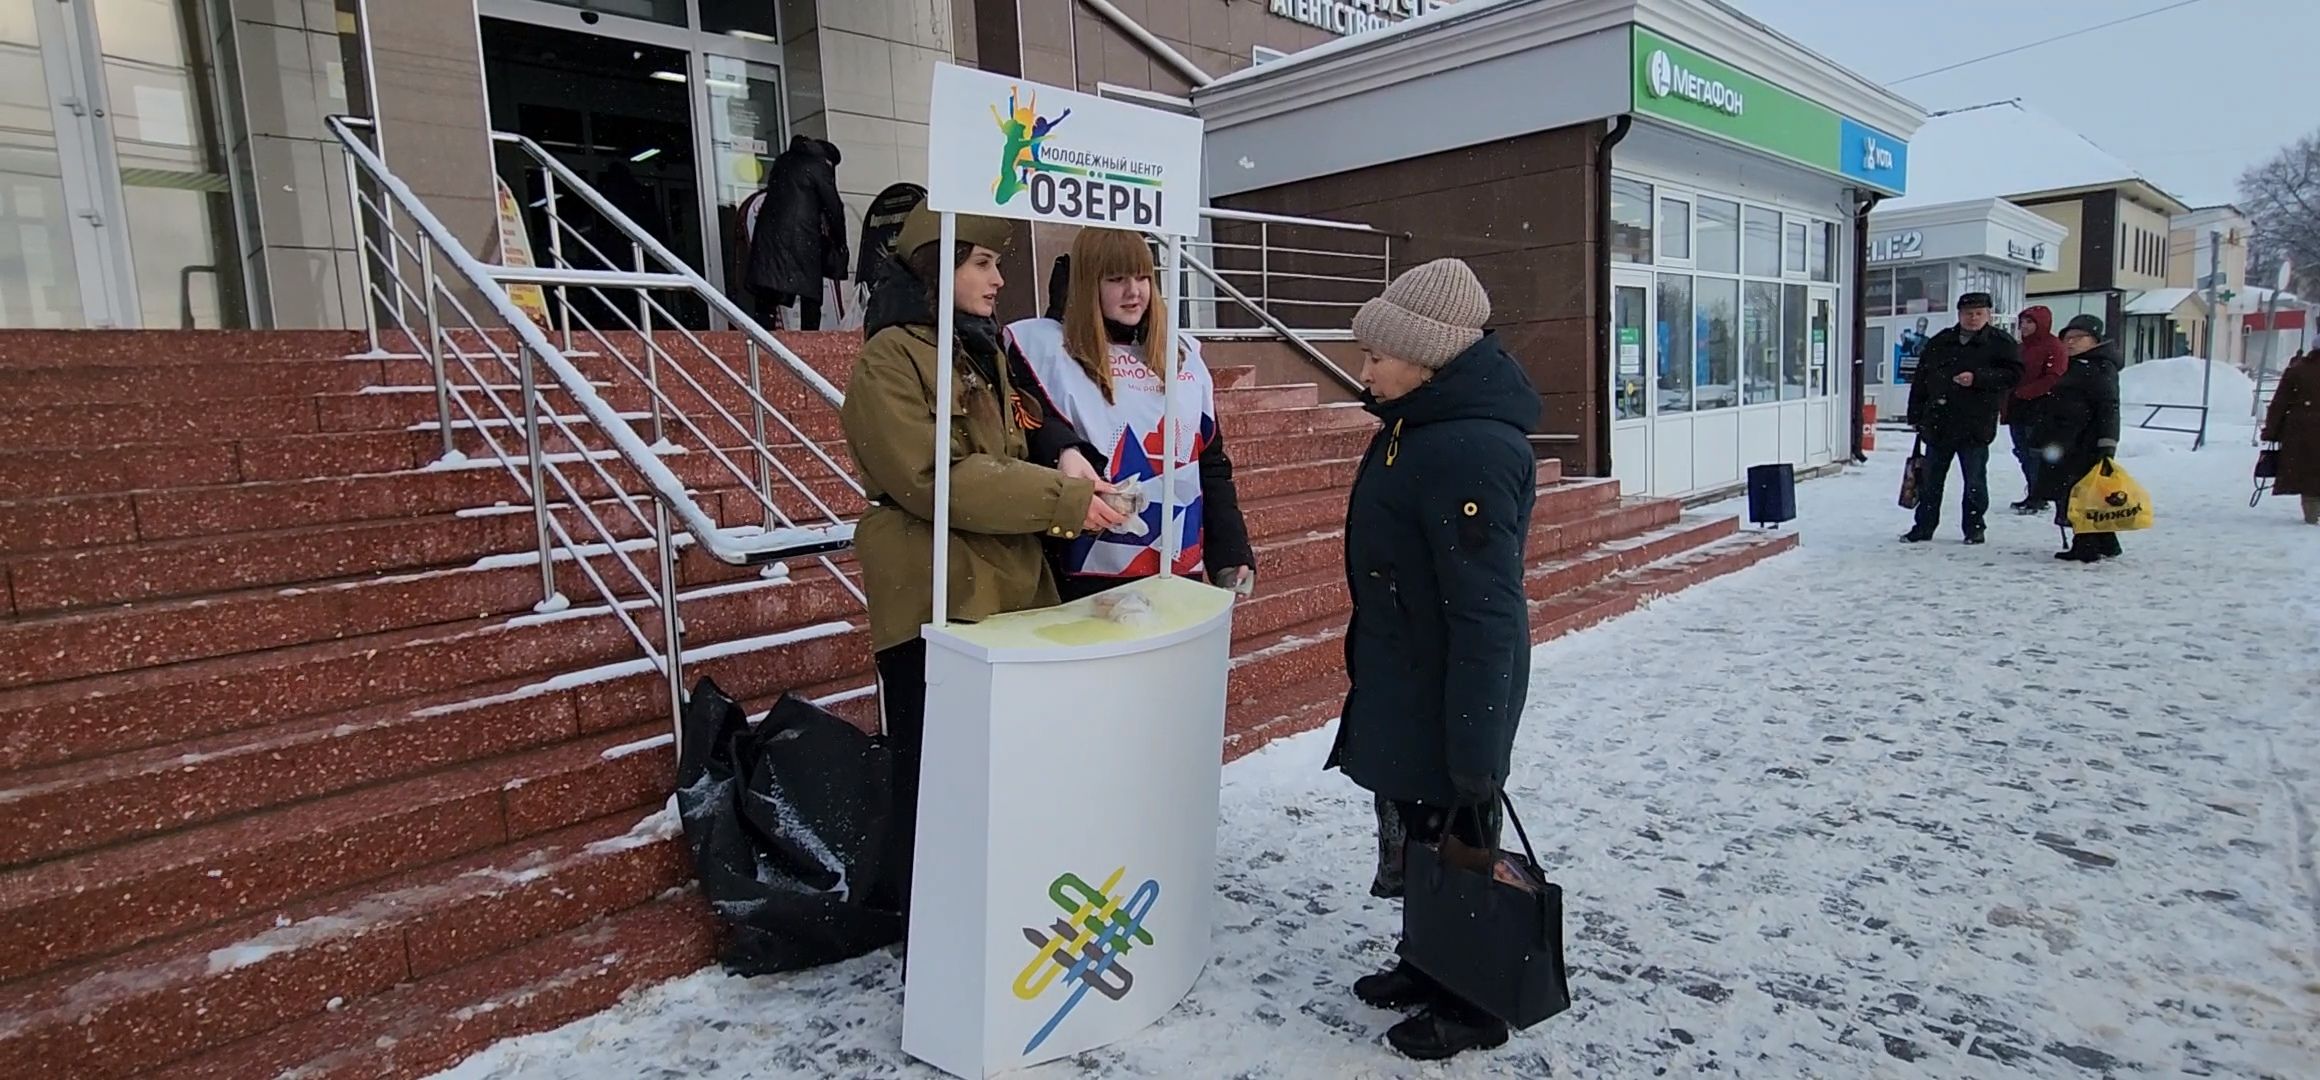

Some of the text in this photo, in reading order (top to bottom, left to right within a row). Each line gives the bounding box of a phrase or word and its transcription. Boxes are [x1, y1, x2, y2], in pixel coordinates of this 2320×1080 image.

[1040, 145, 1164, 177] МОЛОДЁЖНЫЙ ЦЕНТР
[1029, 170, 1163, 227] ОЗЁРЫ
[1866, 231, 1923, 262] LE2
